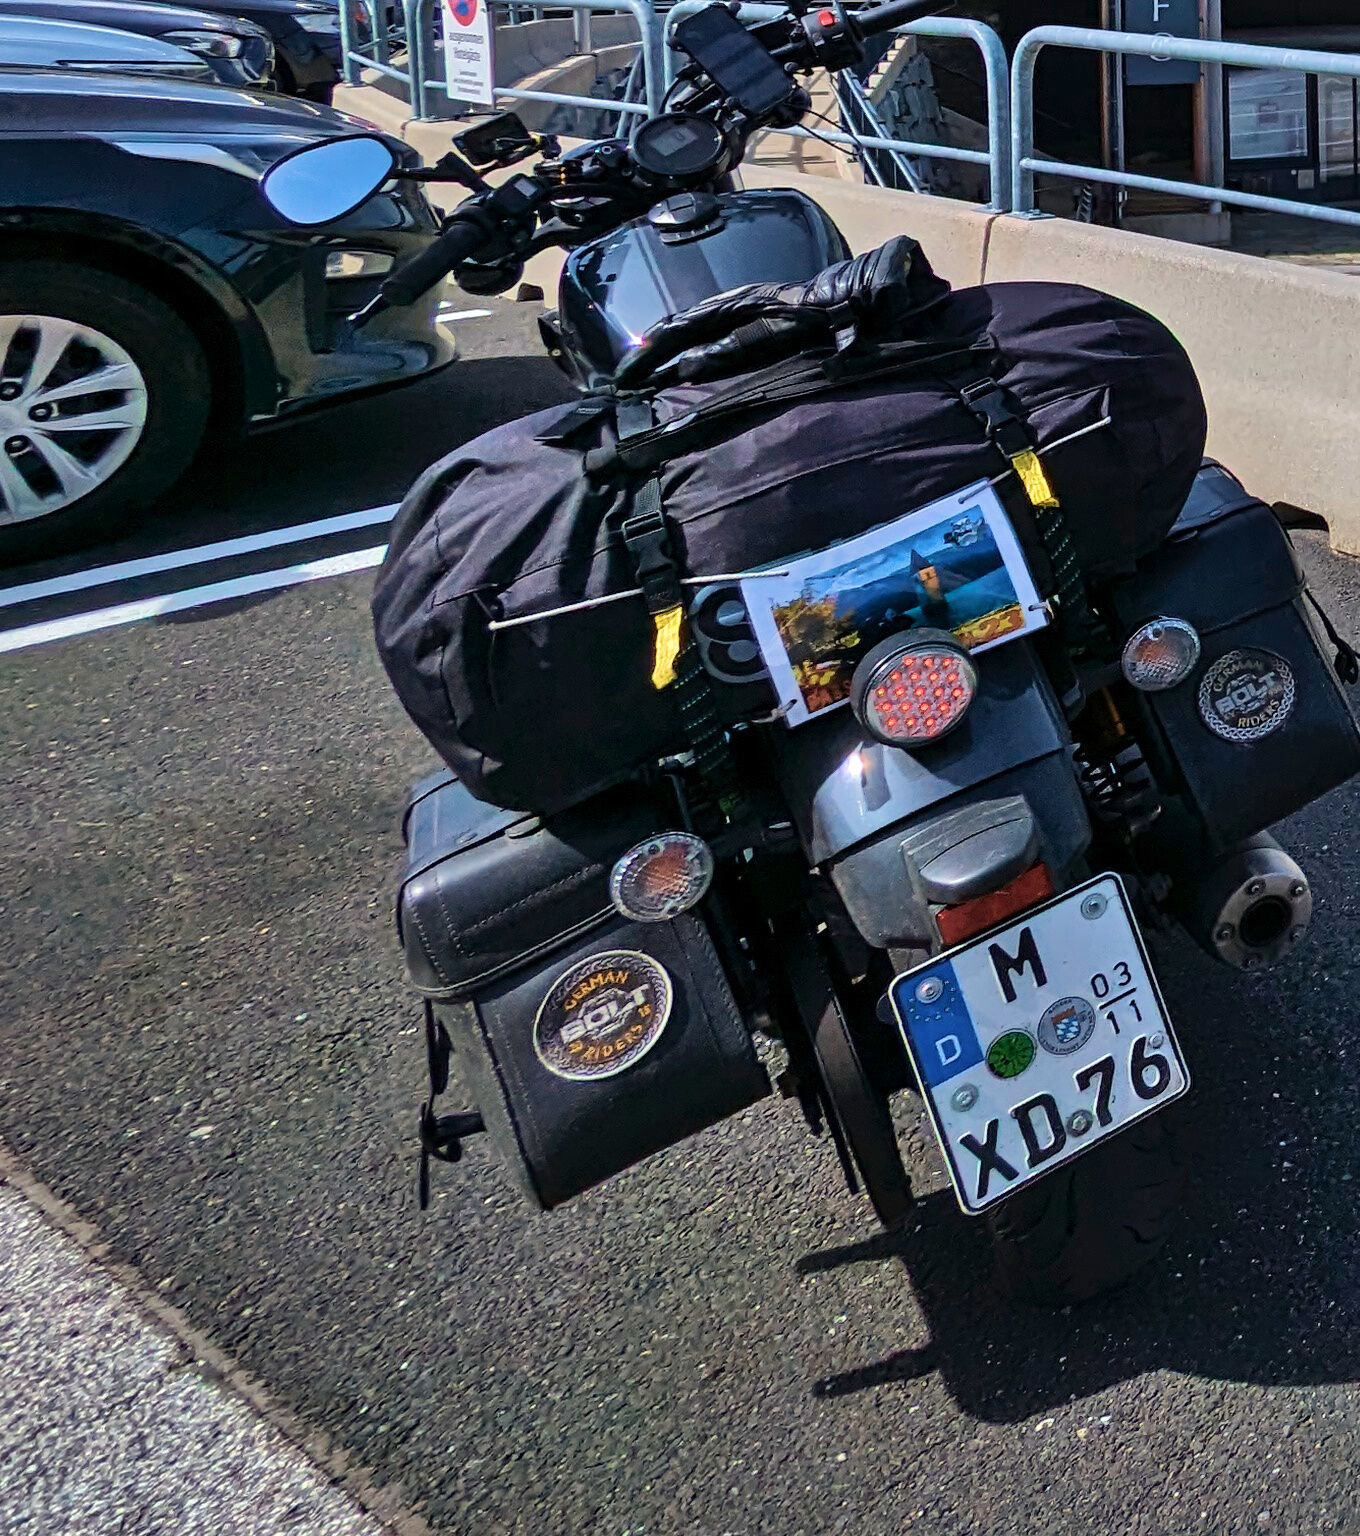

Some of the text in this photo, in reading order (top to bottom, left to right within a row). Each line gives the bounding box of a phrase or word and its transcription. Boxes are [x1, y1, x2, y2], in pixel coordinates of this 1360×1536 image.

[1215, 671, 1275, 714] BOLT
[1237, 699, 1280, 728] RIDERS
[988, 926, 1048, 1003] M
[1090, 961, 1132, 998] 03
[563, 970, 630, 1012] GERMAN
[559, 983, 650, 1045] BOLT
[1106, 1000, 1142, 1035] 11
[581, 1023, 643, 1061] RIDERS
[935, 1034, 962, 1066] D
